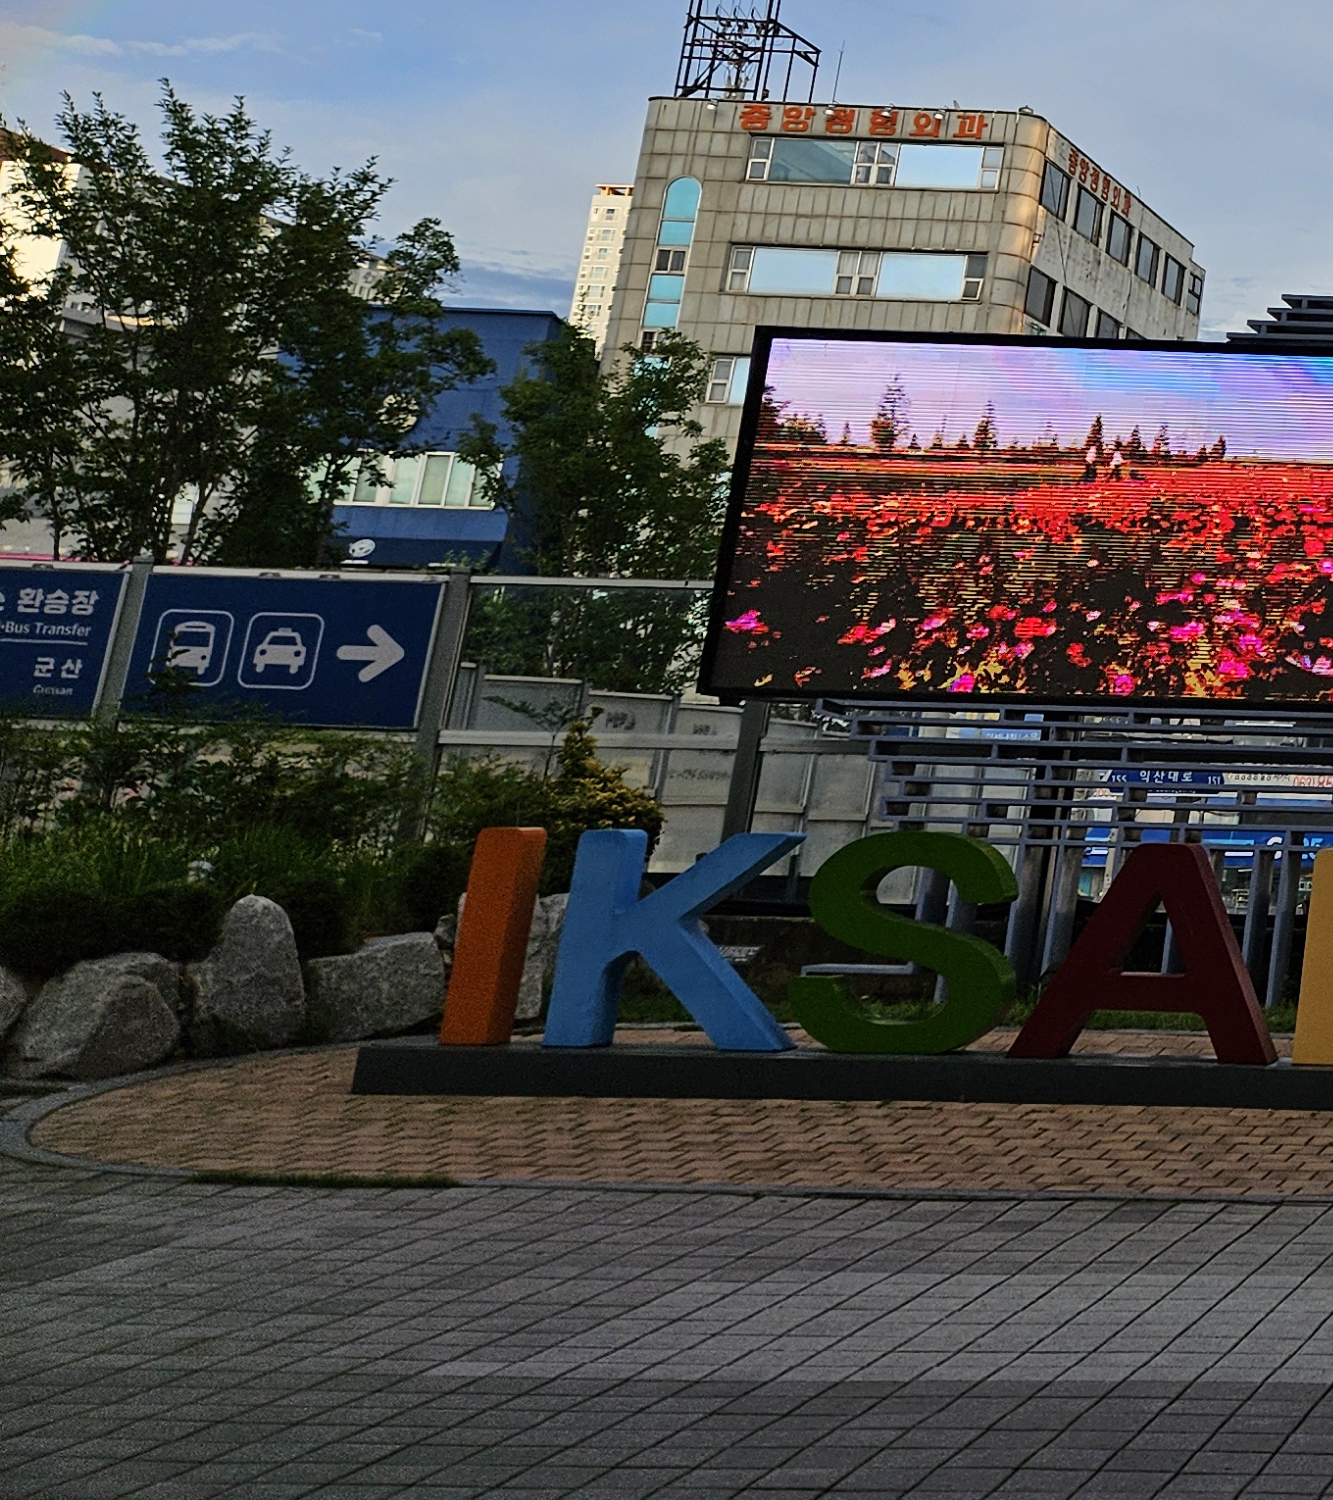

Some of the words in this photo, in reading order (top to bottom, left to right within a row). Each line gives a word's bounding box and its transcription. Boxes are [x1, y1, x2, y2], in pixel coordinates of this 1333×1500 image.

[739, 103, 989, 140] 중앙정형외과
[1068, 147, 1132, 218] 중앙정형외과
[17, 587, 99, 616] 환승장
[34, 621, 92, 637] Transfer
[1139, 770, 1194, 784] 익산대로
